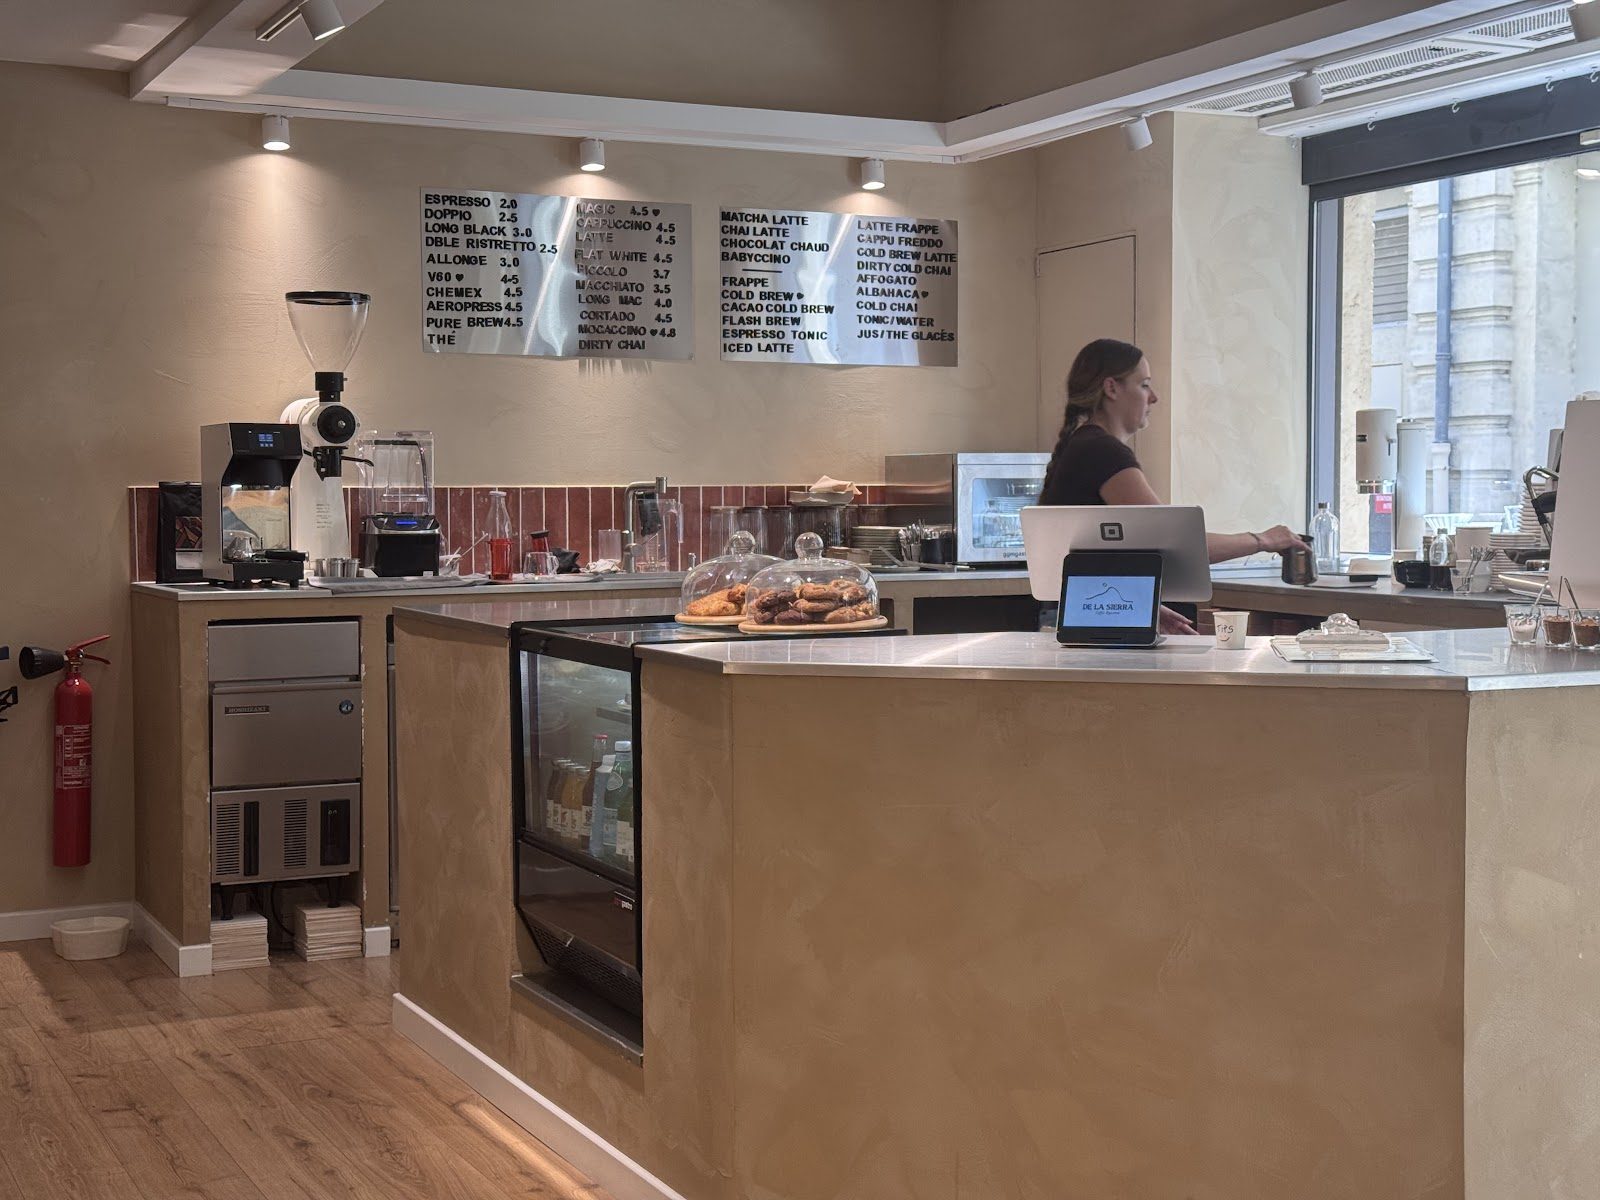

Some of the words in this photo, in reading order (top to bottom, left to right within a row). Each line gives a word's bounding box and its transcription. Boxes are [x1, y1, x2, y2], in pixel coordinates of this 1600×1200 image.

[425, 194, 490, 207] ESPRESSO
[500, 199, 517, 209] 2.0
[576, 203, 615, 215] MAGIC
[630, 206, 649, 216] 4.5
[425, 209, 472, 220] DOPPIO
[499, 212, 518, 223] 2.5
[721, 211, 768, 223] MATCHA
[772, 215, 808, 225] LATTE
[425, 222, 459, 233] LONG
[464, 224, 506, 236] BLACK
[513, 228, 532, 237] 3.0
[576, 218, 652, 231] CAPPUCCINO
[656, 223, 676, 233] 4.5
[721, 225, 749, 235] CHAI
[753, 227, 790, 237] LATTE
[857, 220, 893, 231] LATTE
[896, 223, 939, 234] FRAPPE
[575, 231, 613, 243] LATTE
[656, 234, 676, 245] 4.5
[857, 234, 894, 245] CAPPU
[898, 237, 943, 248] FREDDO
[426, 237, 460, 247] DBLE
[466, 238, 536, 252] RISTRETTO
[540, 244, 558, 254] 2.5
[721, 238, 785, 250] CHOCOLAT
[790, 242, 829, 252] CHAUD
[426, 253, 487, 266] ALLONGE
[500, 257, 519, 267] 3.0
[575, 248, 603, 260] FLAT
[609, 250, 647, 262] WHITE
[653, 253, 673, 263] 4.5
[721, 252, 790, 264] BABYCCINO
[857, 248, 886, 257] COLD
[889, 250, 921, 260] BREW
[924, 252, 957, 262] LATTE
[576, 263, 628, 276] PICCOLO
[653, 269, 671, 279] 3.7
[857, 261, 891, 272] DIRTY
[894, 264, 922, 273] COLD
[924, 265, 951, 275] CHAI
[428, 272, 451, 282] V60
[501, 274, 519, 284] 4.5
[722, 277, 769, 287] FRAPPE
[857, 274, 917, 285] AFFOGATO
[426, 287, 482, 297] CHEMEX
[504, 287, 523, 297] 4.5
[575, 280, 644, 292] MACCHIATO
[653, 284, 671, 294] 3.5
[856, 287, 920, 299] ALBAHACA
[578, 294, 610, 304] LONG
[619, 295, 642, 306] MAC
[654, 299, 672, 308] 4.0
[721, 290, 754, 300] COLD
[760, 291, 794, 300] BREW
[426, 301, 503, 312] AEROPRESS
[505, 302, 523, 312] 4.5
[721, 303, 763, 312] CACAO
[766, 304, 797, 313] COLD
[801, 304, 834, 314] BREW
[856, 301, 886, 311] COLD
[890, 303, 918, 312] CHAI
[426, 317, 462, 329] PURE
[467, 317, 503, 327] BREW
[504, 317, 523, 327] 4.5
[580, 311, 635, 321] CORTADO
[655, 313, 673, 323] 4.5
[722, 316, 761, 325] FLASH
[766, 317, 801, 325] BREW
[578, 325, 646, 336] MOCACCINO
[659, 328, 676, 337] 4.8
[723, 329, 785, 339] ESPRESSO
[791, 330, 828, 340] TONIC
[912, 329, 954, 340] GLACÉS
[427, 330, 456, 345] THÉ
[579, 340, 613, 349] DIRTY
[618, 340, 646, 349] CHAI
[723, 343, 753, 352] ICED
[758, 343, 794, 353] LATTE
